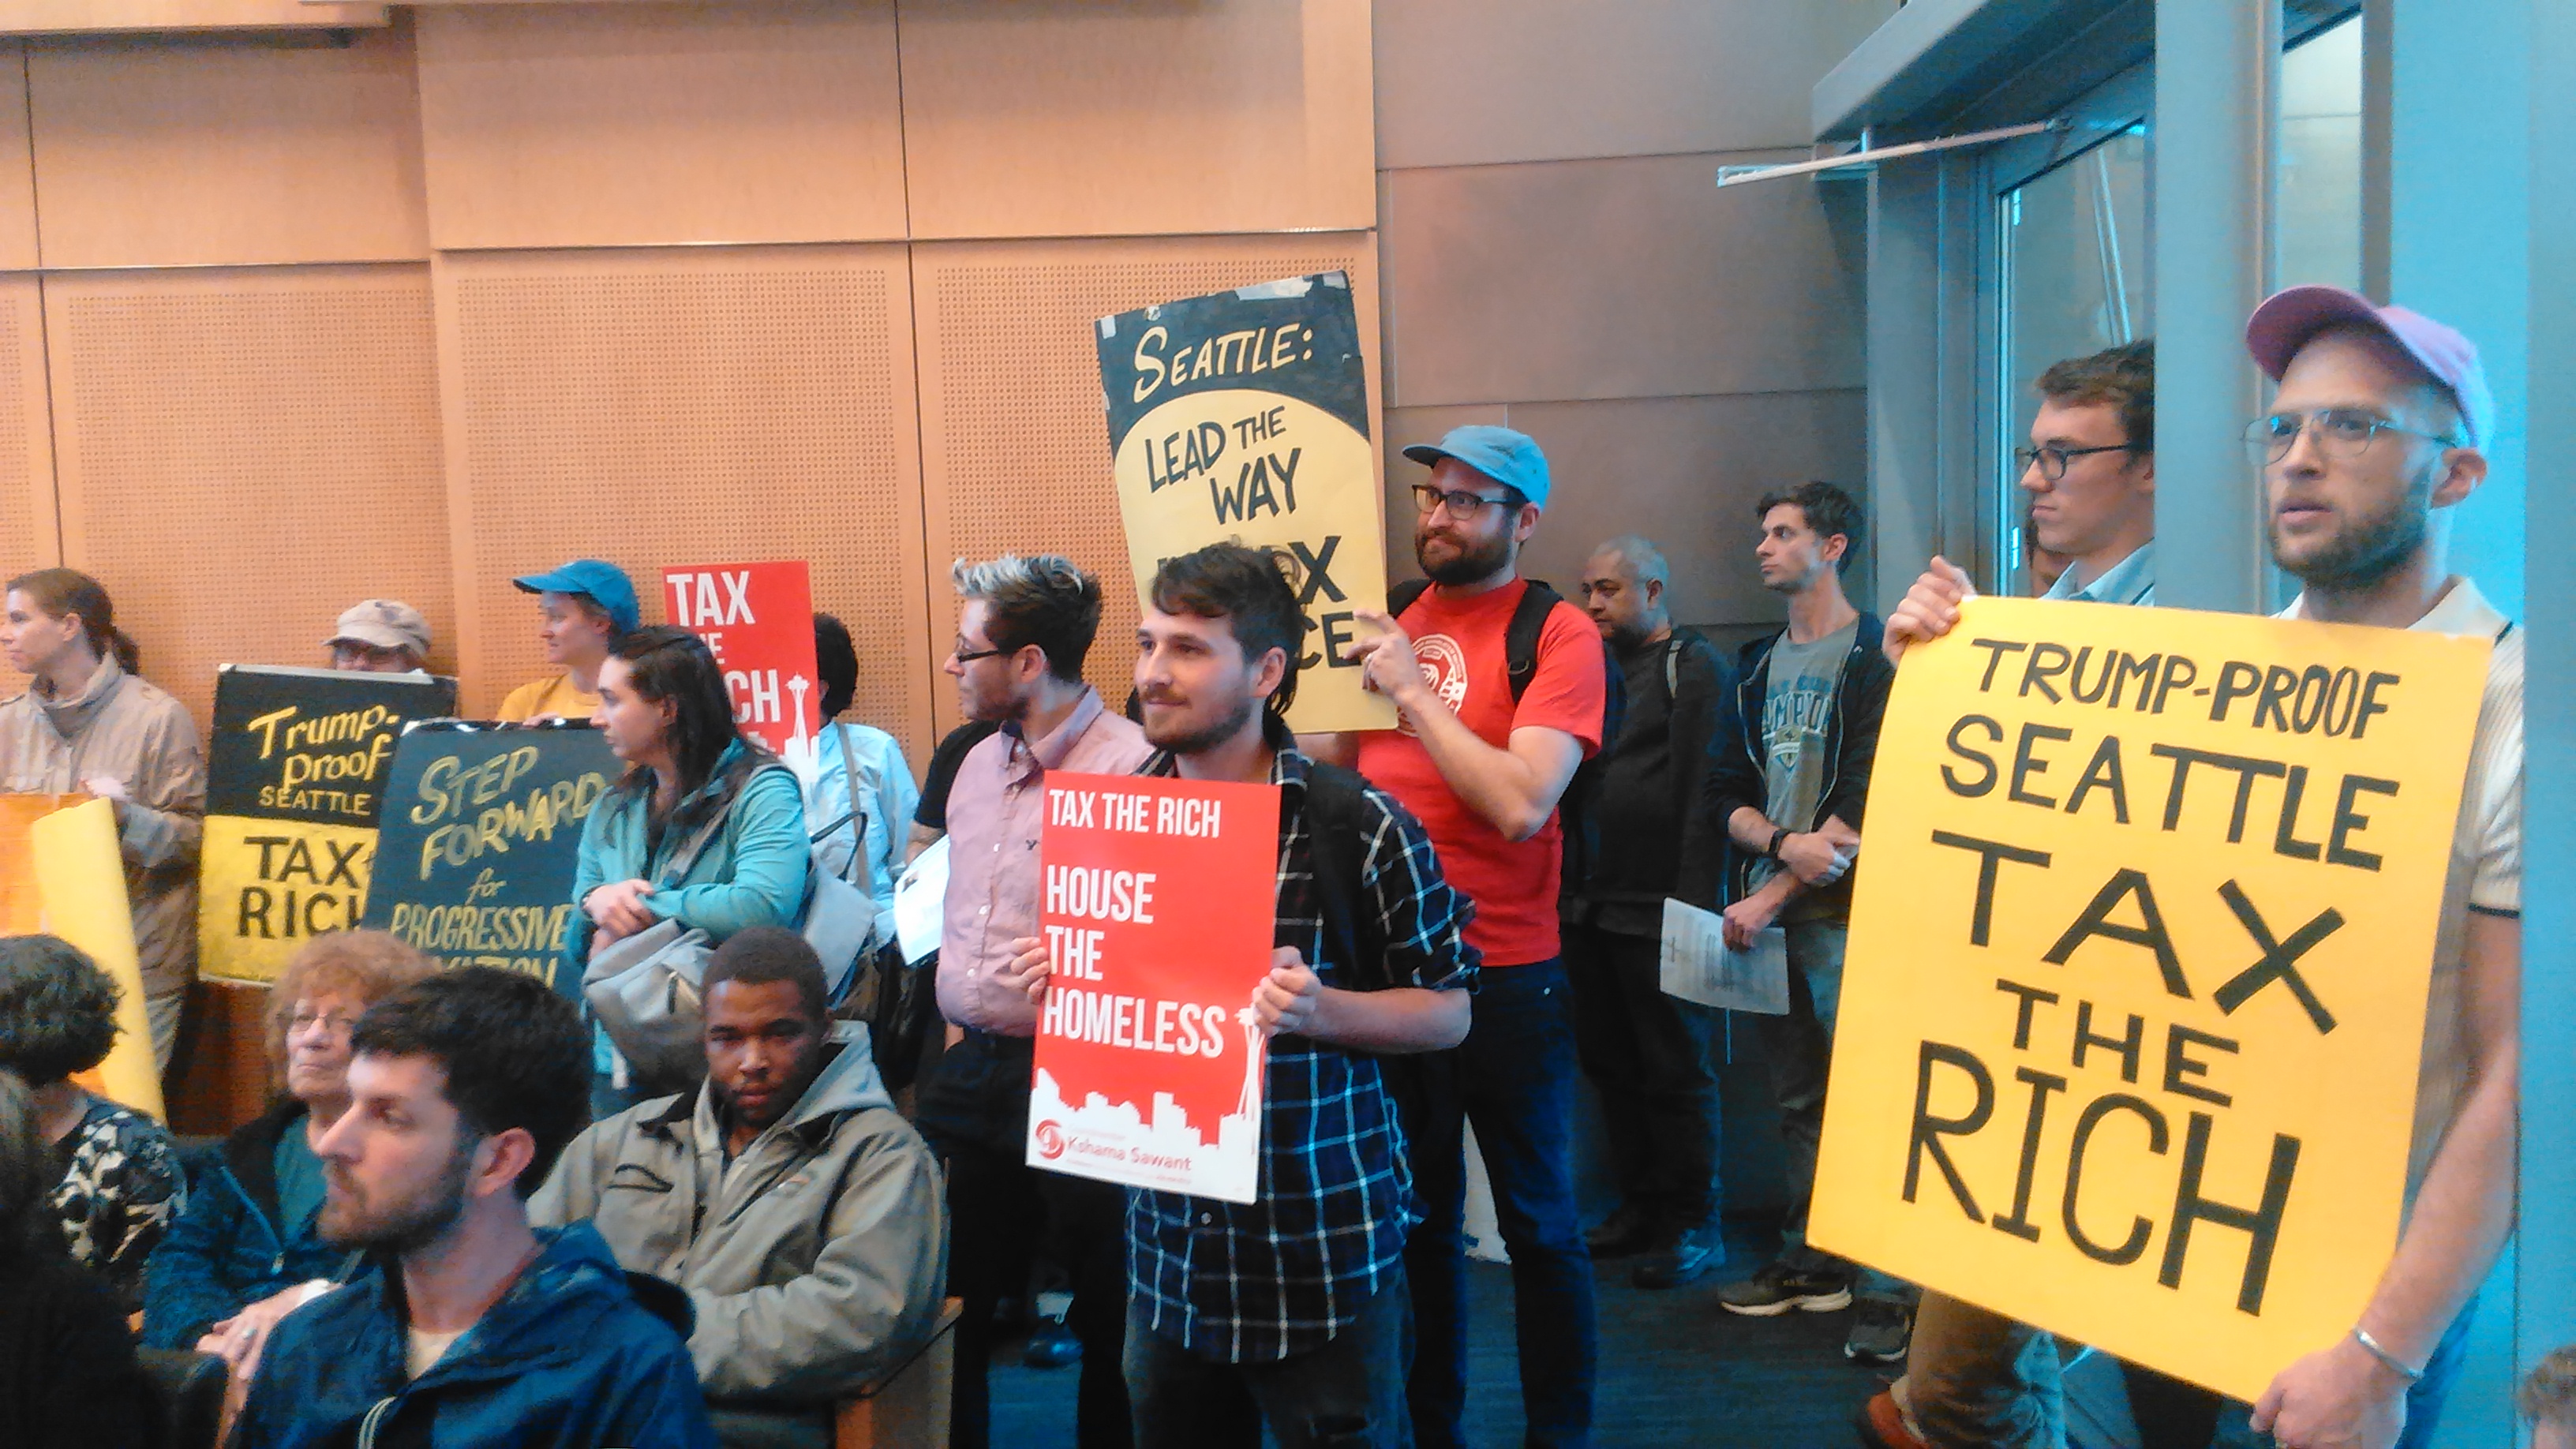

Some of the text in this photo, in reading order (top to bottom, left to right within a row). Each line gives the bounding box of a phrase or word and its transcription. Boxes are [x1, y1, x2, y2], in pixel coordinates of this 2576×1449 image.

[1133, 323, 1313, 404] SEATTLE:
[1144, 405, 1287, 494] LEAD THE
[1210, 447, 1301, 526] WAY
[666, 571, 755, 627] TAX
[724, 669, 781, 724] CH
[1971, 638, 2399, 739] TRUMP-PROOF
[283, 733, 393, 794] proof
[410, 745, 539, 825] STEP
[1940, 713, 2400, 872] SEATTLE
[259, 785, 372, 816] SEATTLE
[419, 772, 607, 881] FORWARD
[1050, 789, 1221, 838] TAX THE RICH
[243, 836, 365, 889] TAX
[465, 867, 507, 905] for
[1046, 864, 1156, 925] HOUSE
[389, 902, 576, 952] PROGRESSIVE
[1045, 925, 1105, 981] THE
[1932, 829, 2346, 1036] TAX
[1043, 987, 1226, 1058] HOMELESS
[1996, 978, 2240, 1108] THE
[1068, 1136, 1192, 1170] Kshama Sawant
[1902, 1039, 2303, 1317] RICH
